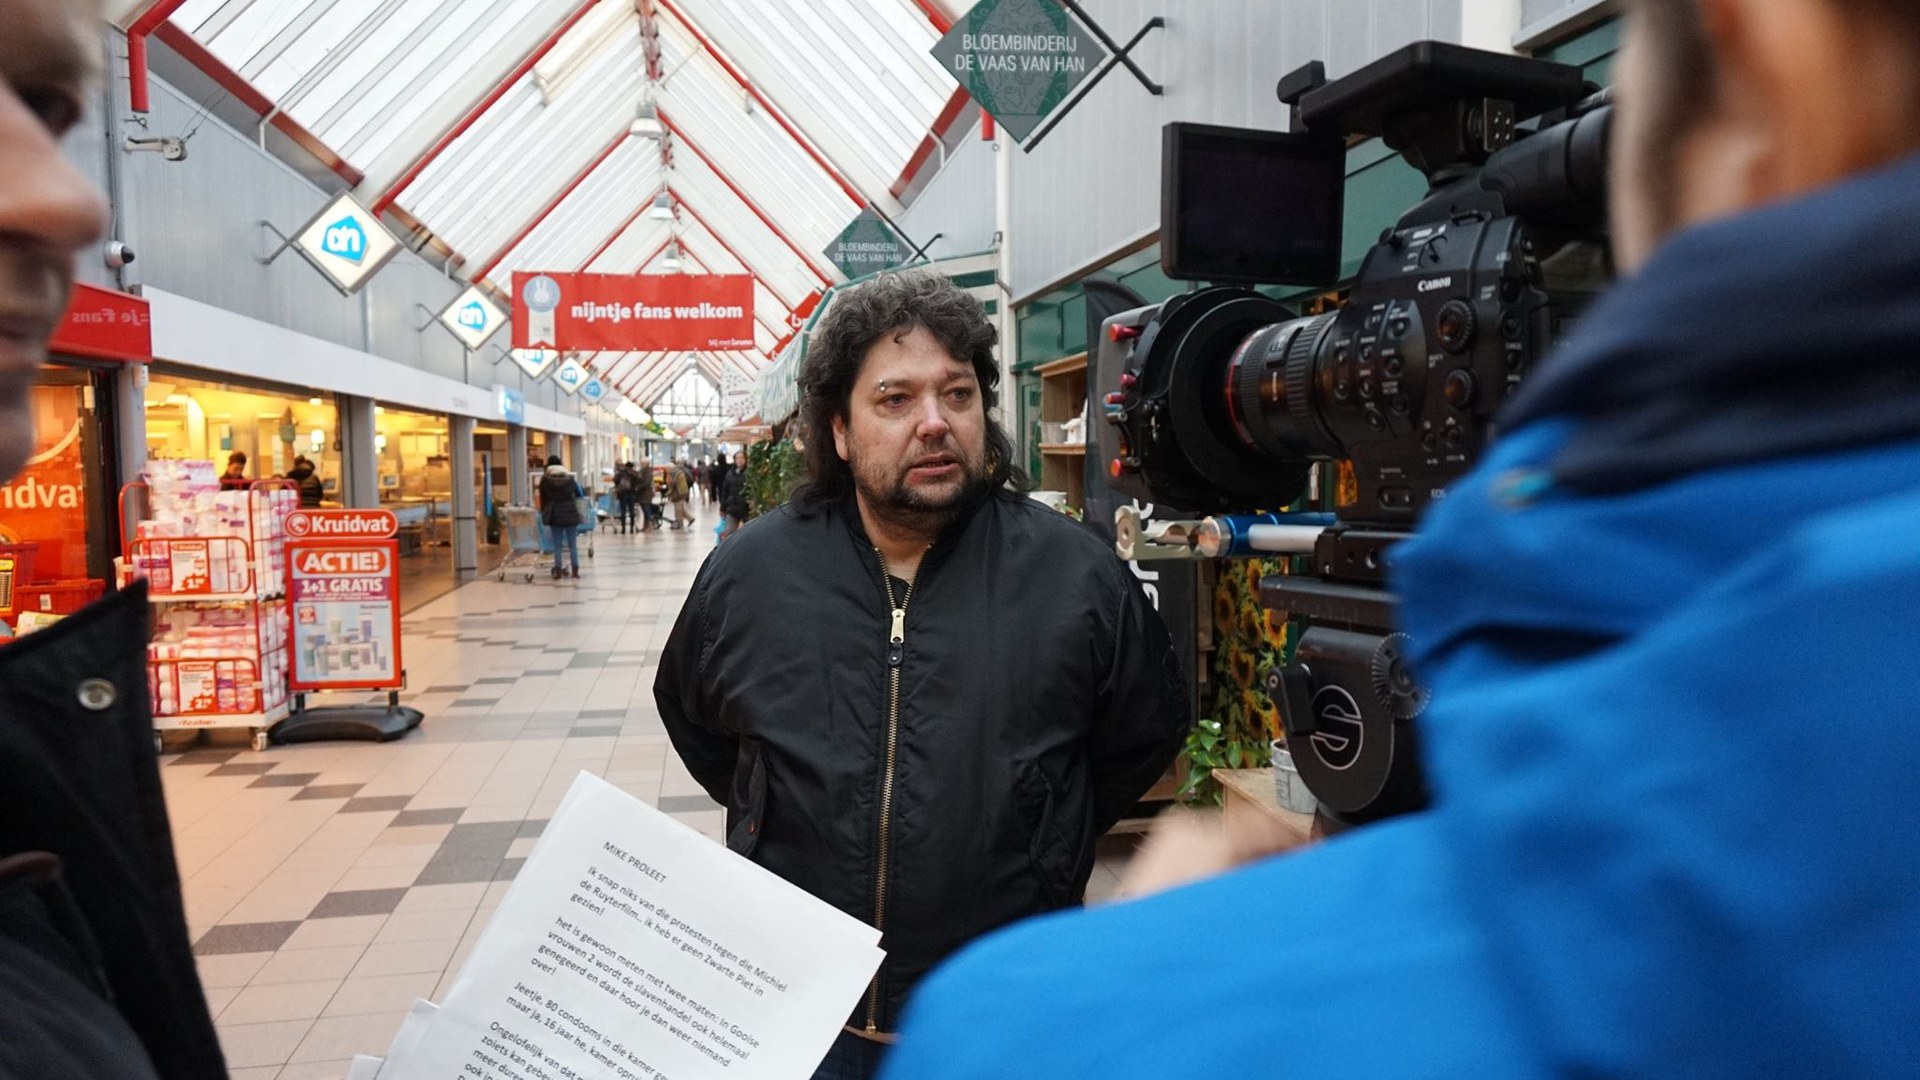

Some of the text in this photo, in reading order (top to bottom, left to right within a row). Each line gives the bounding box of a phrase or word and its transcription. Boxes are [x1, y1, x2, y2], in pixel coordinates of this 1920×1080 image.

[962, 33, 1077, 52] BLOEMBINDERIJ
[954, 54, 1085, 72] DE VAAS VAN HAN
[835, 253, 902, 262] DE VAAS VAN HAN
[838, 242, 899, 252] BLOEMBINDERIJ
[1417, 276, 1451, 292] Canon
[571, 302, 743, 323] nijntje fans welkom
[0, 476, 83, 509] idva
[312, 514, 390, 533] Kruidvat
[303, 551, 379, 572] ACTIE!
[301, 578, 383, 593] 1+1 GRATIS
[603, 842, 666, 882] MIKE PROLEET
[570, 894, 605, 915] gezien!
[579, 879, 593, 892] de
[644, 917, 654, 929] ik
[653, 922, 671, 939] heb
[671, 936, 682, 945] er
[681, 943, 703, 959] geen
[704, 955, 734, 978] Zwarte
[736, 974, 753, 990] Piet
[754, 985, 764, 997] in
[587, 866, 787, 991] Ik snap niks van die protesten tegen die Michiel
[531, 958, 557, 975] over!
[555, 915, 759, 1047] het is gewoon meten met twee maten: In Gooise
[538, 945, 730, 1066] genegeerd en daar hoor je dan weer niemand
[548, 932, 749, 1058] vrouwen 2 wordt de slavenhandel ook helemaal
[507, 997, 531, 1013] maar
[528, 1008, 542, 1024] ja,
[543, 1017, 558, 1030] 16
[555, 1025, 574, 1040] jaar
[573, 1035, 587, 1053] he,
[589, 1046, 617, 1068] kamer
[514, 982, 542, 1005] Jeetje,
[544, 999, 559, 1012] 80
[558, 1009, 601, 1040] condooms
[601, 1035, 612, 1048] in
[611, 1043, 627, 1057] die
[627, 1052, 655, 1074] kamer
[473, 1050, 498, 1067] meer
[481, 1036, 509, 1056] zoiets
[508, 1049, 527, 1067] kan
[490, 1022, 577, 1080] Ongelofelijk van dat
[464, 1062, 484, 1079] ook
